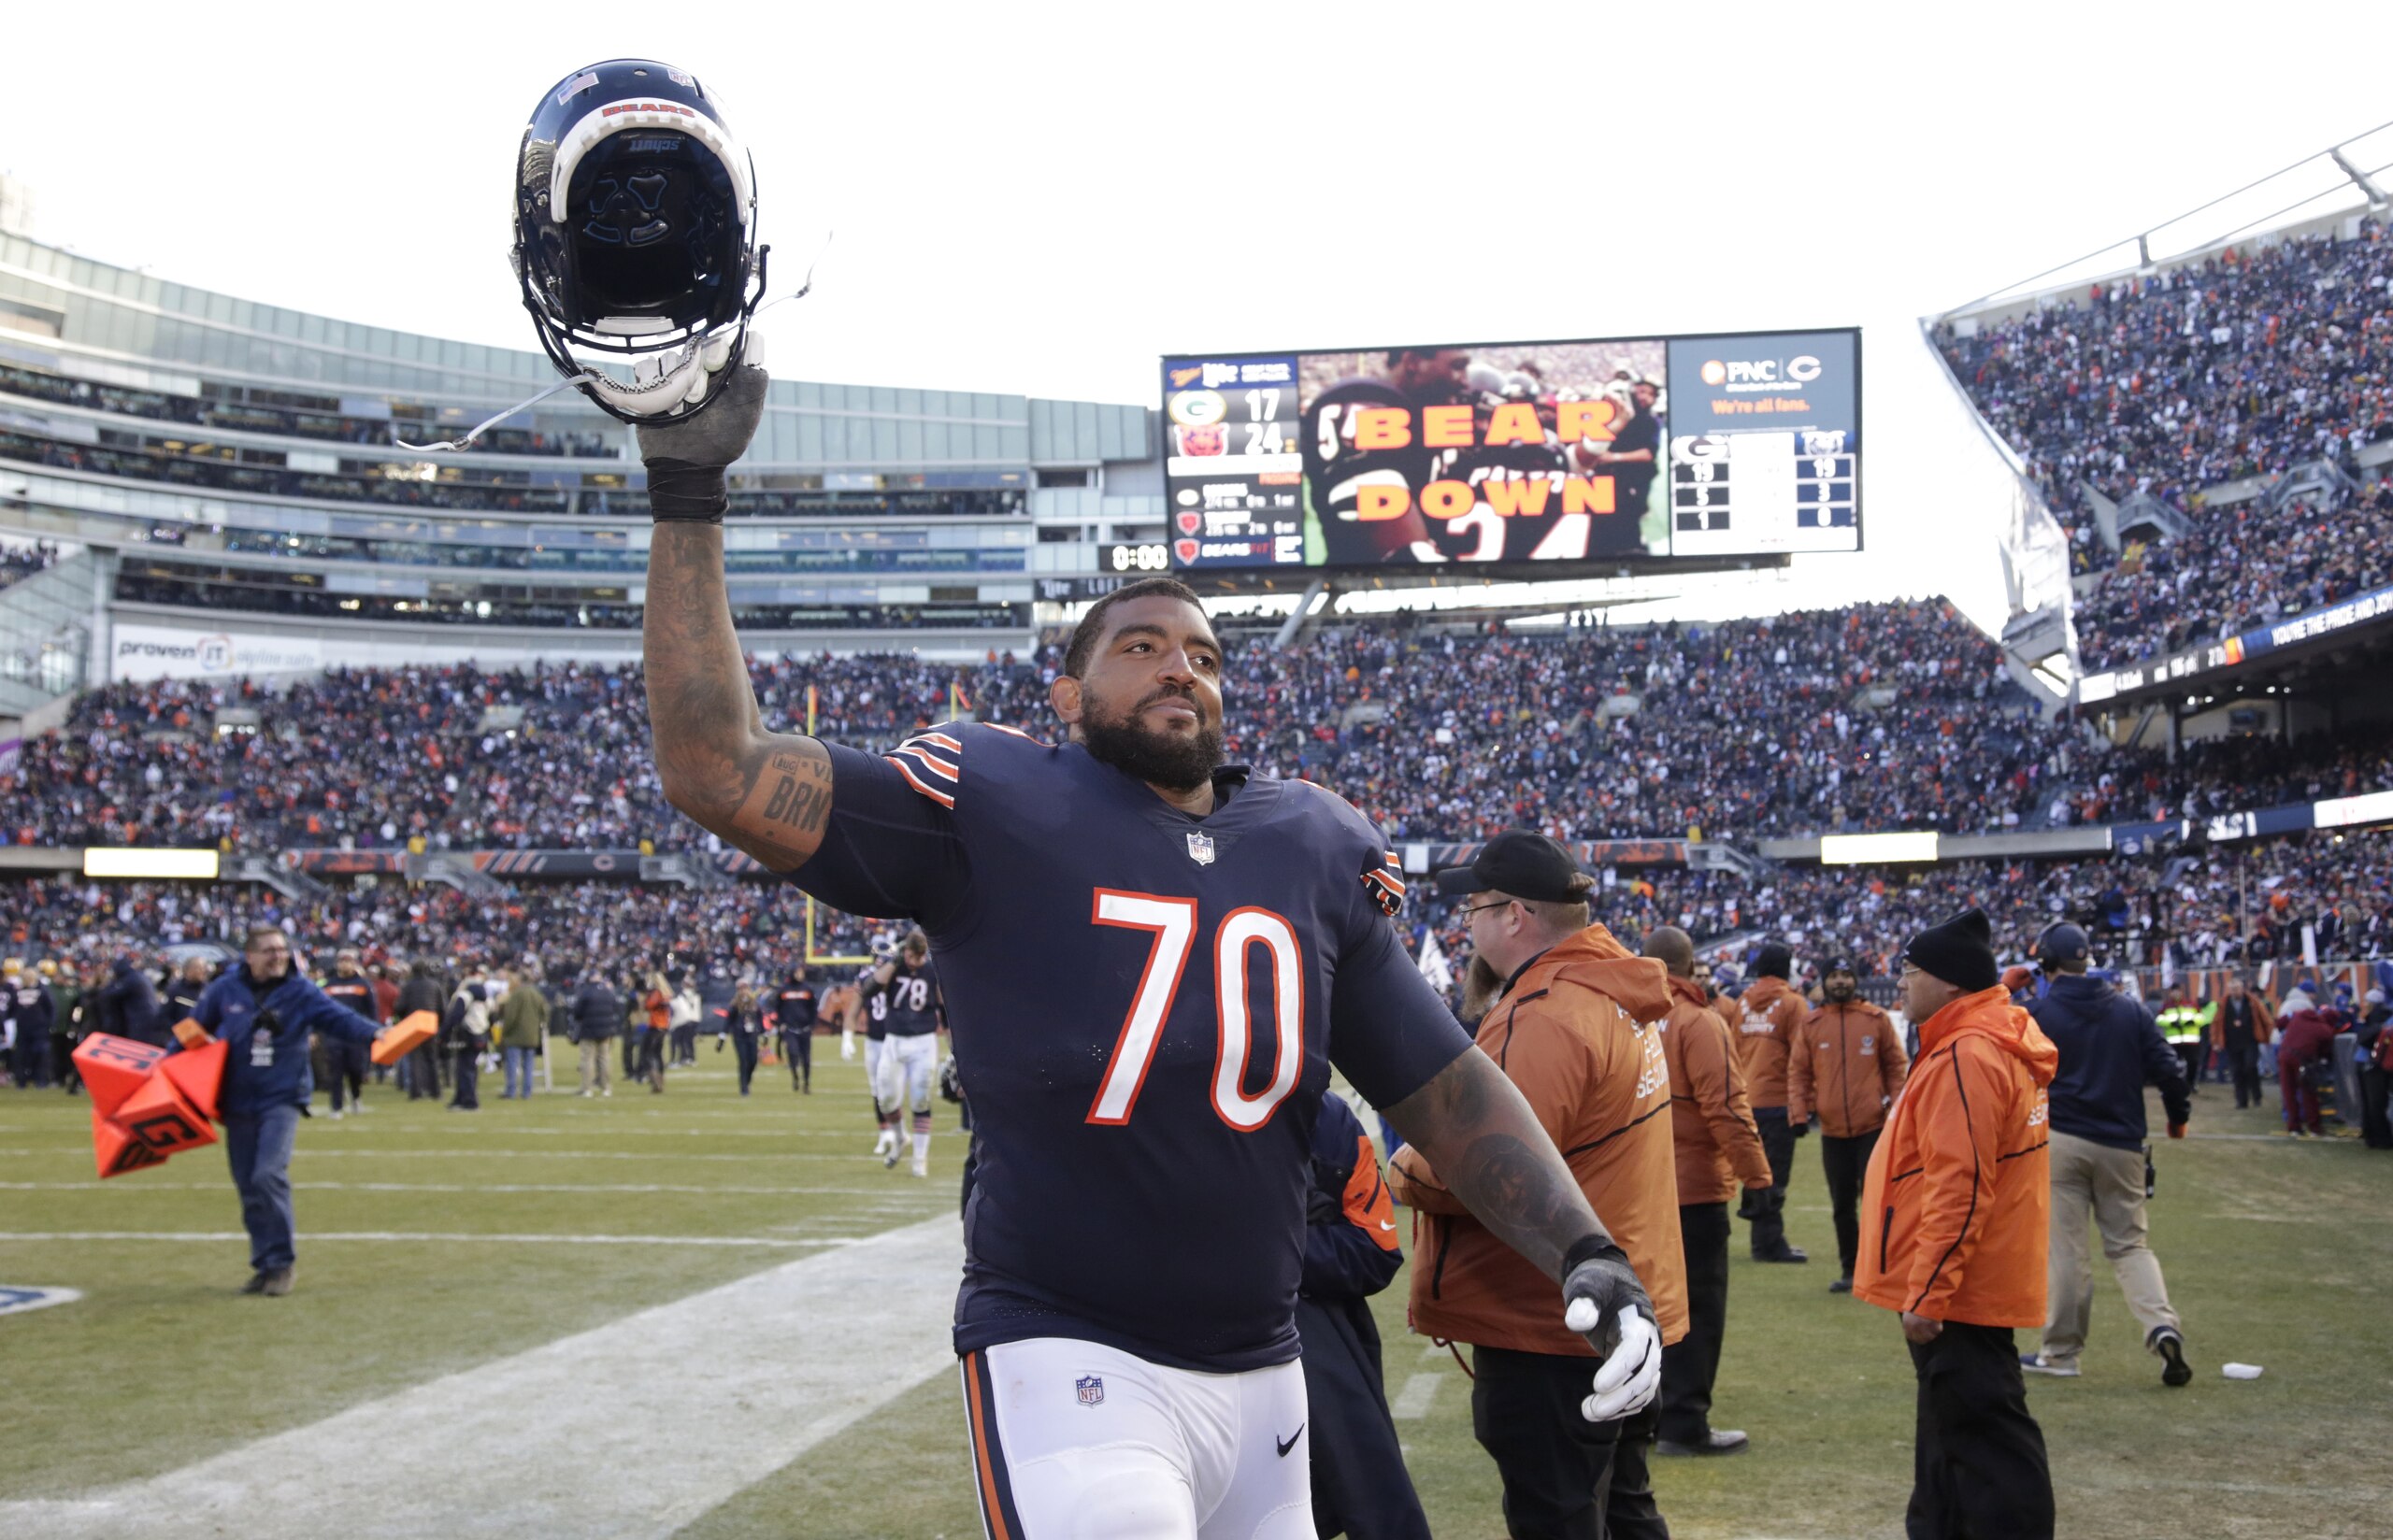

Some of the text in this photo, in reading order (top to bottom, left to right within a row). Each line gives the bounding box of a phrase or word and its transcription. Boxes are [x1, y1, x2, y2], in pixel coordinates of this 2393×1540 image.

[671, 73, 692, 85] NFL
[602, 103, 695, 118] BEARS
[1727, 360, 1776, 381] PNC
[1245, 388, 1281, 421] 17
[1712, 397, 1811, 415] We're all fans.
[1354, 400, 1616, 450] BEAR
[1245, 422, 1283, 455] 24
[1692, 458, 1836, 482] 19 19
[1357, 476, 1616, 520] DOWN
[1697, 481, 1830, 506] 5 3
[1817, 506, 1831, 527] 0
[1112, 545, 1168, 571] 0:00
[120, 640, 223, 662] proven IT
[777, 757, 796, 771] AUG
[893, 976, 928, 1011] 78
[1084, 887, 1305, 1133] 70
[130, 1114, 199, 1148] G
[1081, 1388, 1102, 1401] NFL
